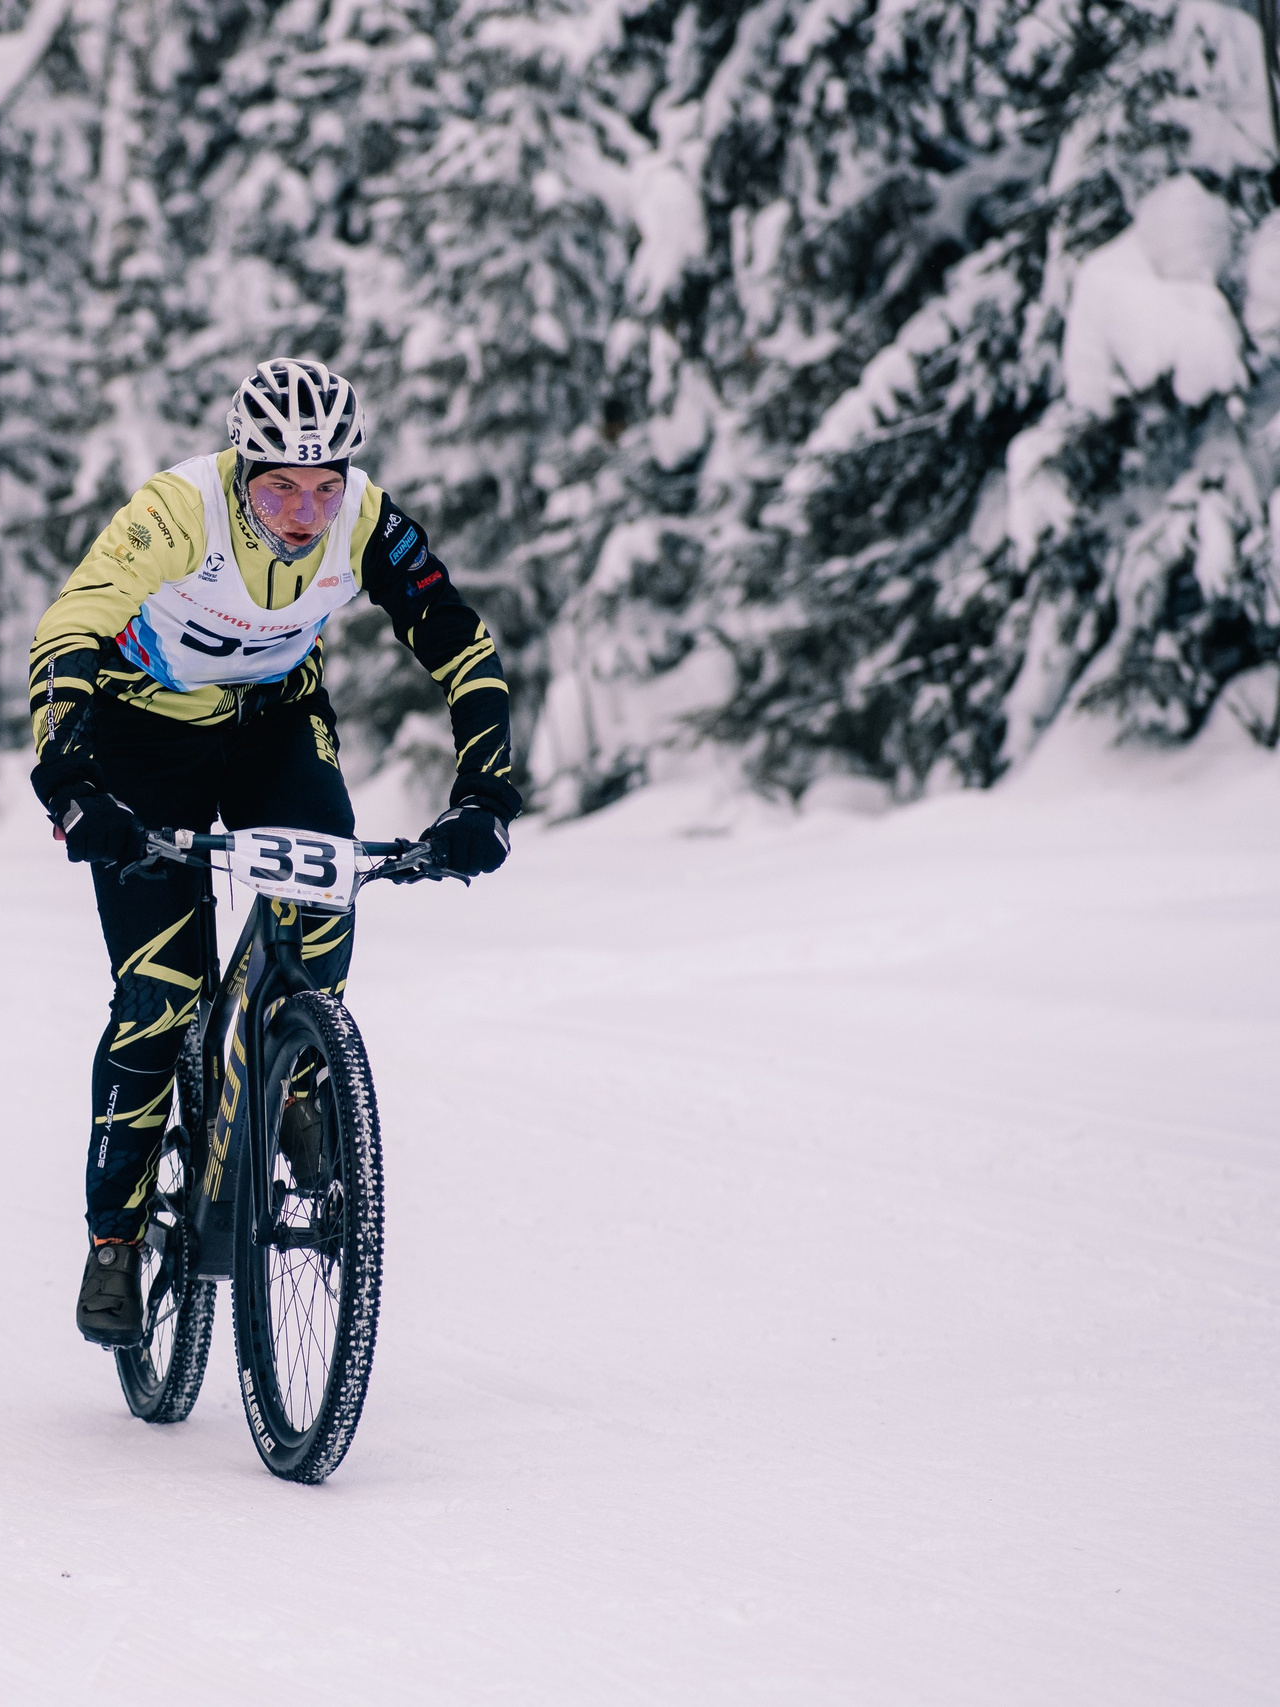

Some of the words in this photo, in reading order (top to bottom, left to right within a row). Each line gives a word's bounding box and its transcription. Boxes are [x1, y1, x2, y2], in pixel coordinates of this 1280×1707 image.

[297, 443, 322, 462] 33
[146, 505, 176, 549] USPORTS
[202, 570, 218, 579] World
[46, 652, 57, 704] VICTORY
[46, 709, 56, 741] CODE
[249, 832, 338, 889] 33
[104, 1084, 120, 1132] VICTORY
[97, 1135, 109, 1169] CODE
